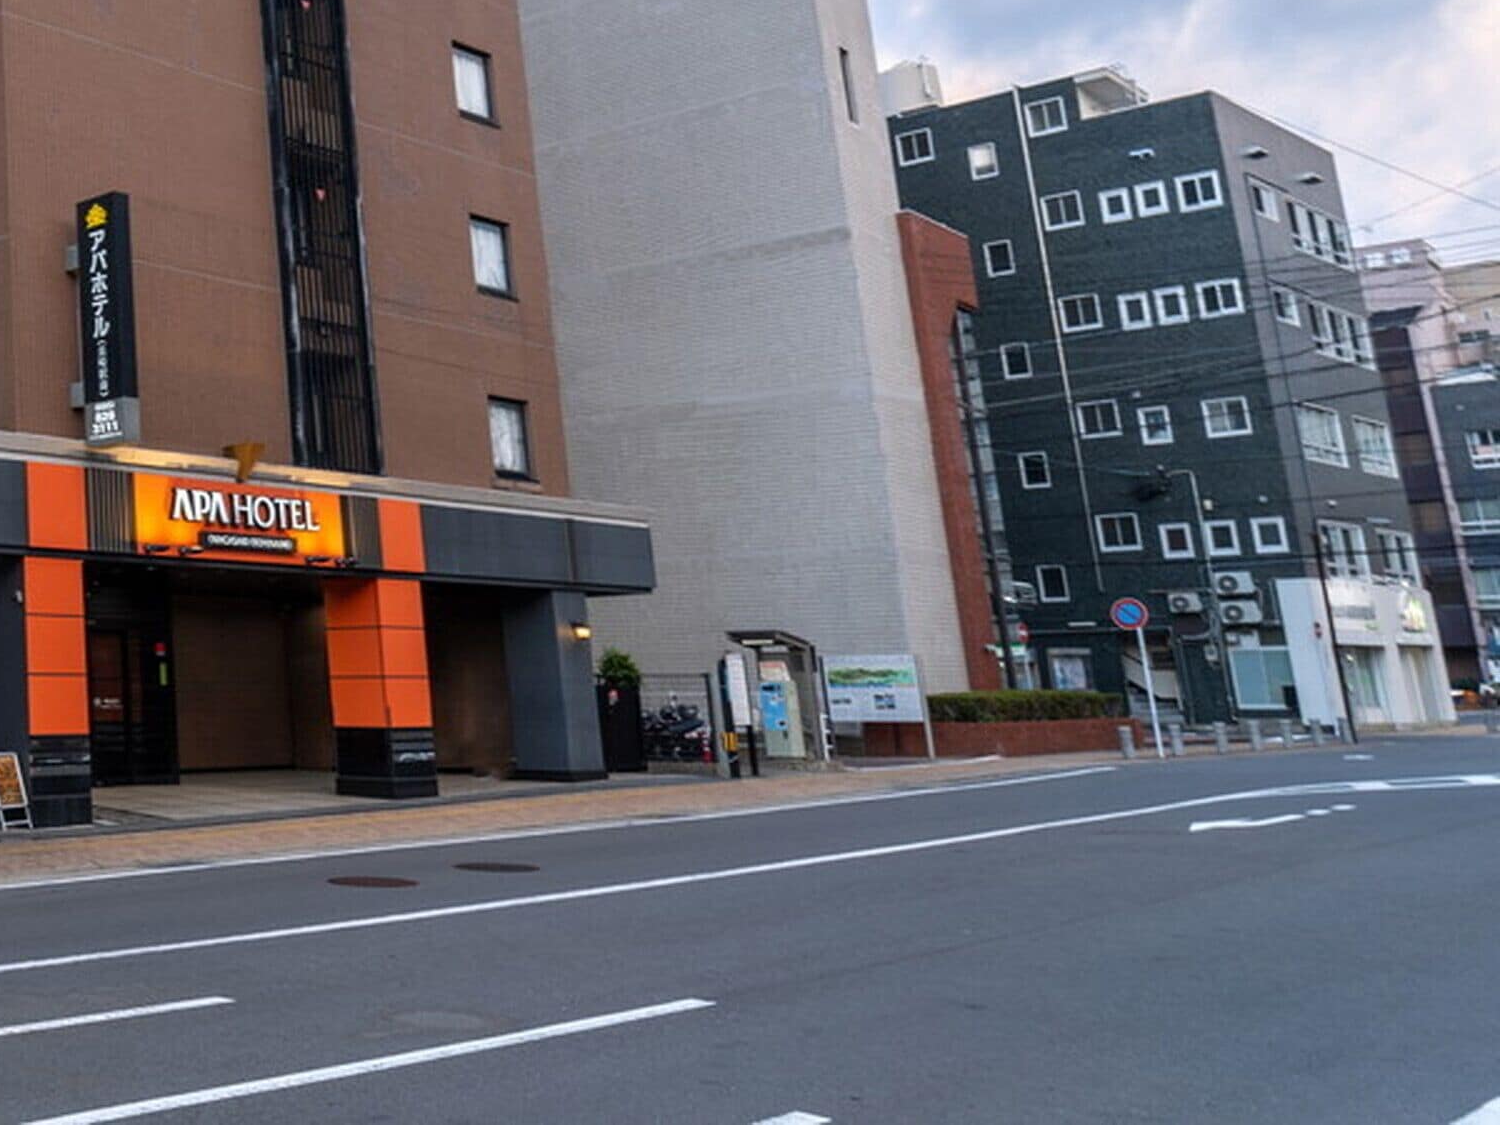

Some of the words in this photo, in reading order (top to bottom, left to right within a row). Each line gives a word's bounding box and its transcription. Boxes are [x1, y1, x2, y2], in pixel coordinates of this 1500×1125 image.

[88, 229, 110, 339] アパホテル
[172, 488, 229, 524] APA
[234, 493, 320, 532] HOTEL
